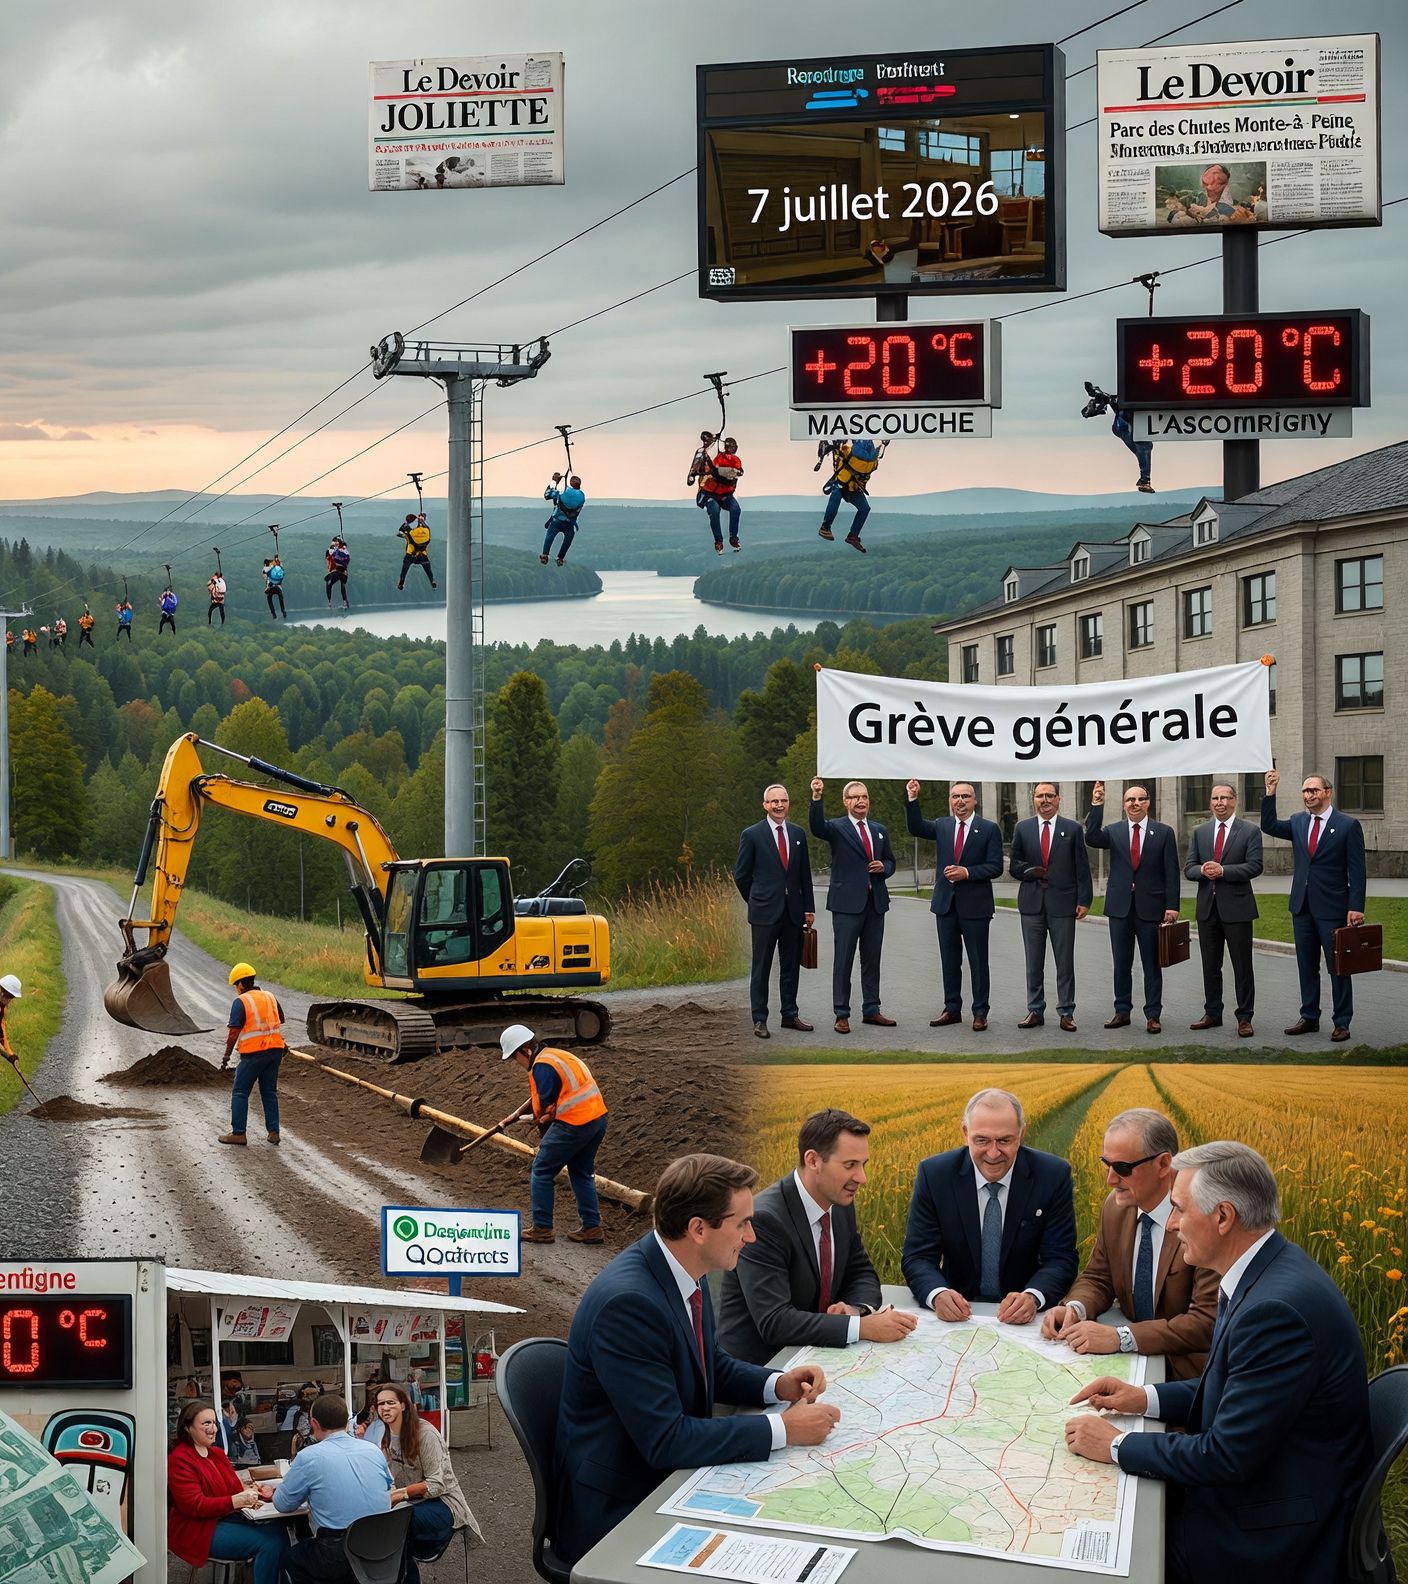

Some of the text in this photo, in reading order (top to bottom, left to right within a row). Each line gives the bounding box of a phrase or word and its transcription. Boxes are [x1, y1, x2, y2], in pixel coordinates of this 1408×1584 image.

[403, 69, 432, 93] Le
[436, 63, 520, 91] Devoir
[1137, 66, 1184, 101] Le
[1188, 58, 1315, 97] Devoir
[380, 97, 549, 133] JOLIETTE
[1109, 122, 1144, 138] Parc
[1148, 119, 1175, 137] des
[1178, 117, 1231, 135] Chutes
[747, 180, 999, 232] 7 juillet 2026
[805, 335, 916, 395] +20
[1138, 329, 1263, 395] +20
[808, 412, 974, 436] MASCOUCHE
[848, 693, 1238, 761] Grève générale
